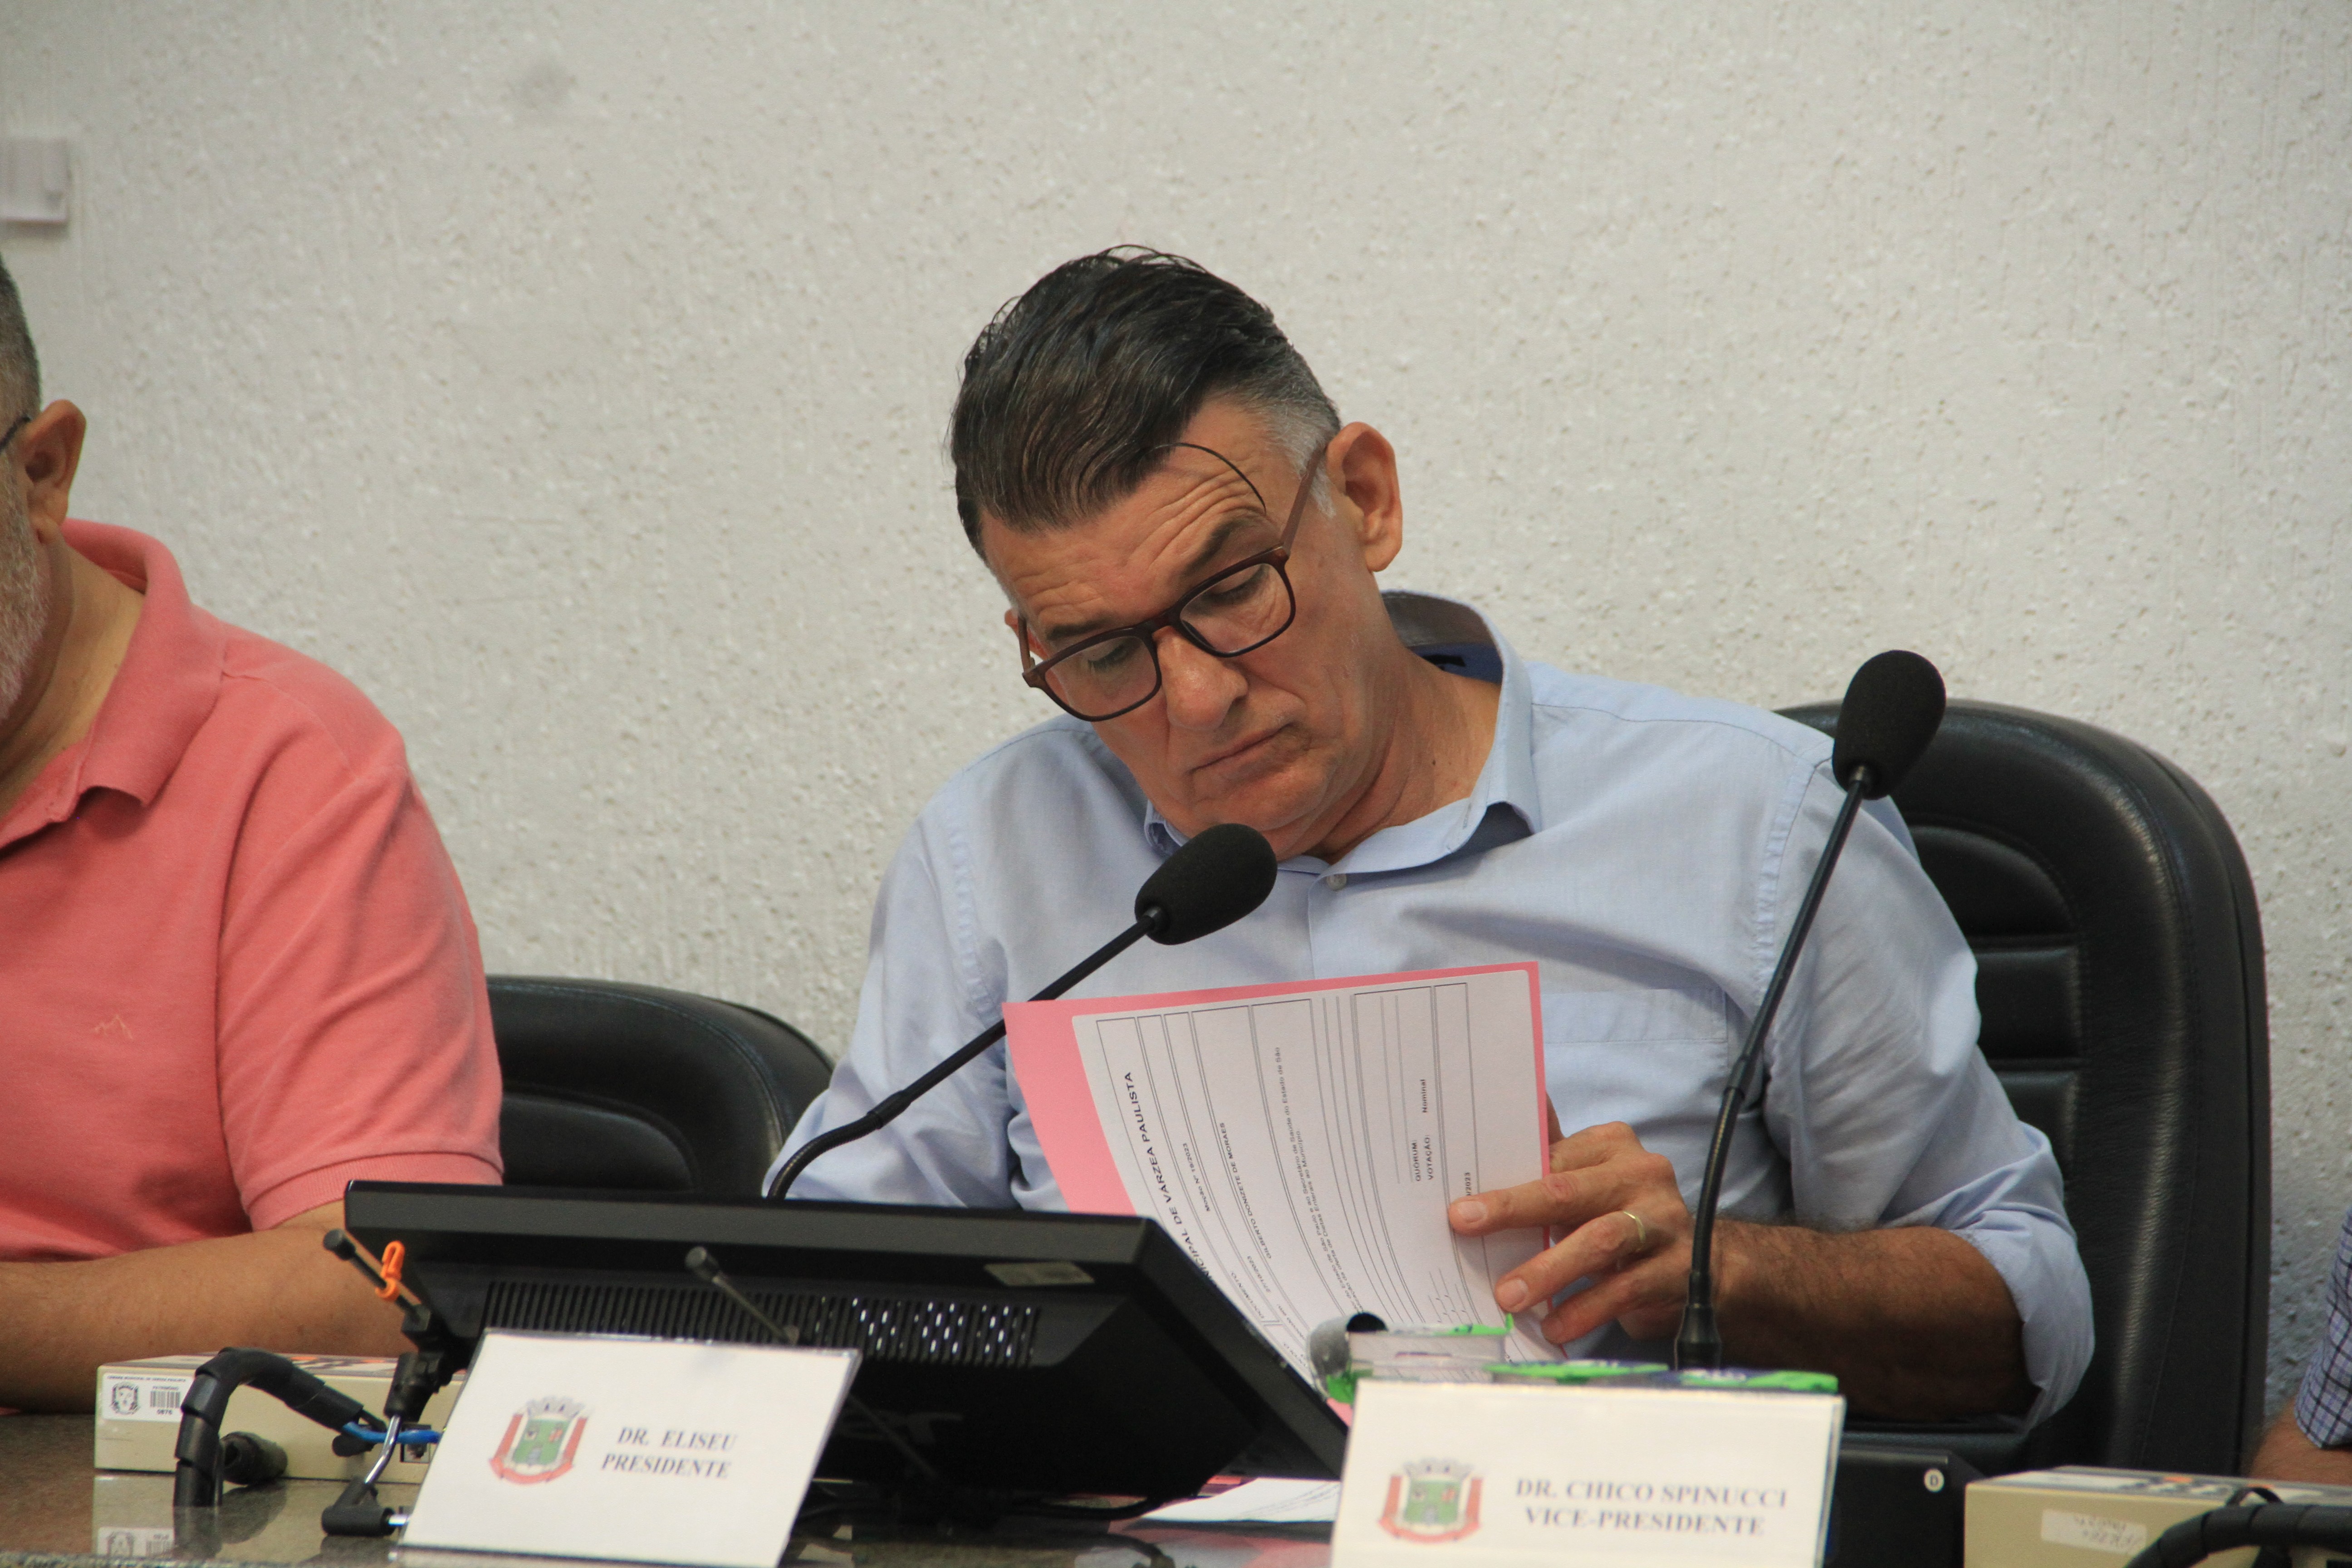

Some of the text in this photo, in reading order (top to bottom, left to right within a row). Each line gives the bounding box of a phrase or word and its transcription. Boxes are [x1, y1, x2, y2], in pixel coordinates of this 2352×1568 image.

[1278, 1064, 1283, 1075] de
[1279, 1077, 1288, 1103] Estado
[1420, 1079, 1428, 1113] Nominal
[1124, 1072, 1150, 1142] PAULISTA
[1284, 1105, 1289, 1115] do
[1287, 1117, 1295, 1142] Saúde
[1182, 1142, 1195, 1172] 19/2023
[1293, 1144, 1298, 1154] de
[1146, 1146, 1171, 1203] VÁRZEA
[1295, 1156, 1308, 1194] Secretário
[1305, 1169, 1310, 1179] ao
[1220, 1122, 1271, 1259] GILBERTO DONIZETE DE MORAES
[1306, 1196, 1312, 1206] ao
[1308, 1181, 1319, 1211] Enterais
[1169, 1206, 1182, 1225] DE
[1312, 1215, 1322, 1236] Paulo
[1318, 1213, 1328, 1237] Dietas
[1327, 1239, 1333, 1248] de
[1327, 1254, 1333, 1263] de
[1331, 1249, 1342, 1270] oferta
[1332, 1264, 1346, 1289] Estado
[1341, 1272, 1348, 1281] da
[617, 1426, 738, 1451] DR. ELISEU
[601, 1453, 731, 1479] PRESIDENTE
[1516, 1479, 1787, 1508] DR. CHICO SPINUCCI
[1525, 1506, 1765, 1535] VICE-PRESIDENTE
